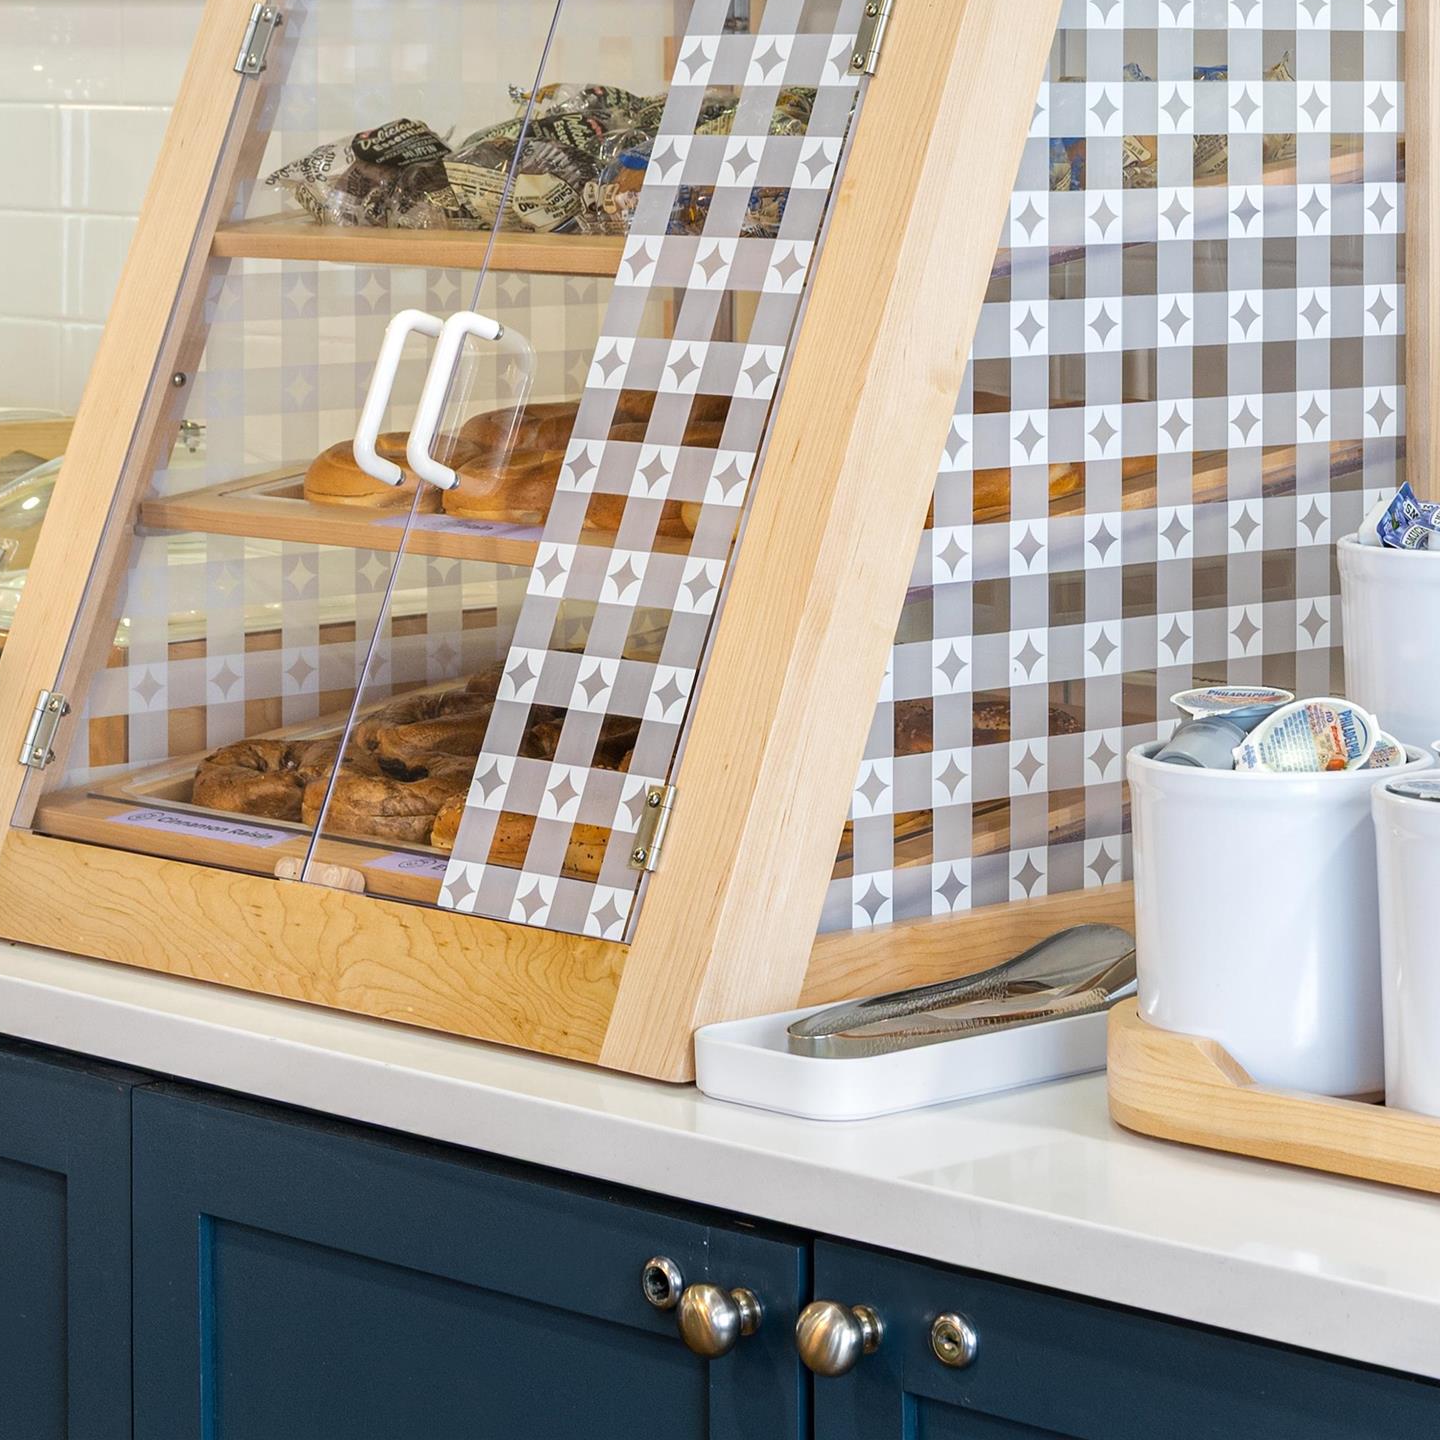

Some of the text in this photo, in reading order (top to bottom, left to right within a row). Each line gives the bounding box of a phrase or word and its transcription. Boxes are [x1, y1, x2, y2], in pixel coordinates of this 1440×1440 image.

[1207, 688, 1277, 698] PHILADELPHIA
[1339, 709, 1361, 760] PHILADELPHIA
[158, 815, 273, 841] Cinnamon Raisin
